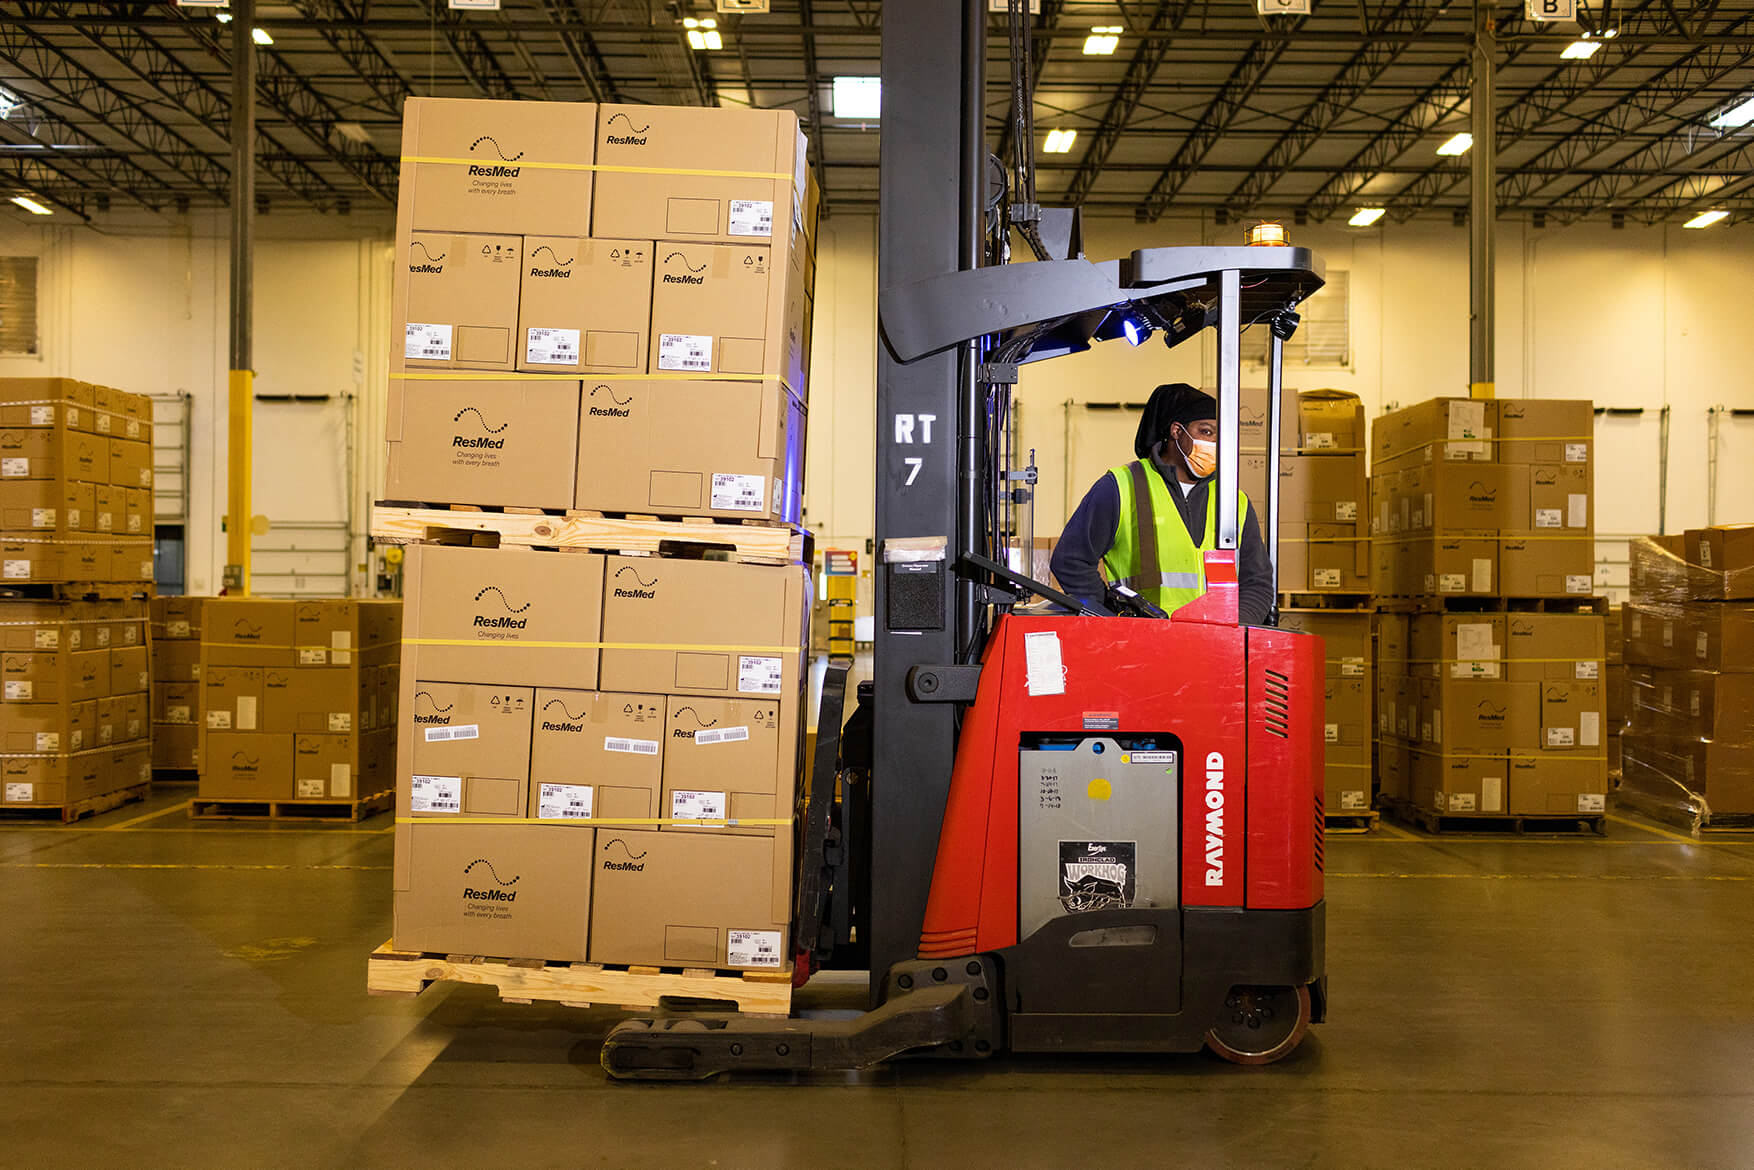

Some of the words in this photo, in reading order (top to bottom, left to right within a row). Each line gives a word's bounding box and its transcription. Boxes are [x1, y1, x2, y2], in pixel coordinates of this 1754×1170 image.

[606, 135, 647, 146] ResMed
[468, 165, 521, 178] ResMed
[530, 267, 571, 278] ResMed
[663, 275, 704, 285] ResMed
[589, 406, 630, 418] ResMed
[895, 414, 936, 444] RT
[453, 436, 505, 449] ResMed
[904, 457, 923, 486] 7
[614, 588, 656, 600] ResMed
[473, 615, 528, 629] ResMed
[542, 721, 583, 733] ResMed
[1205, 751, 1224, 886] RAYMOND
[603, 860, 645, 872] ResMed
[1066, 864, 1127, 884] WORKHOG
[463, 888, 517, 902] ResMed
